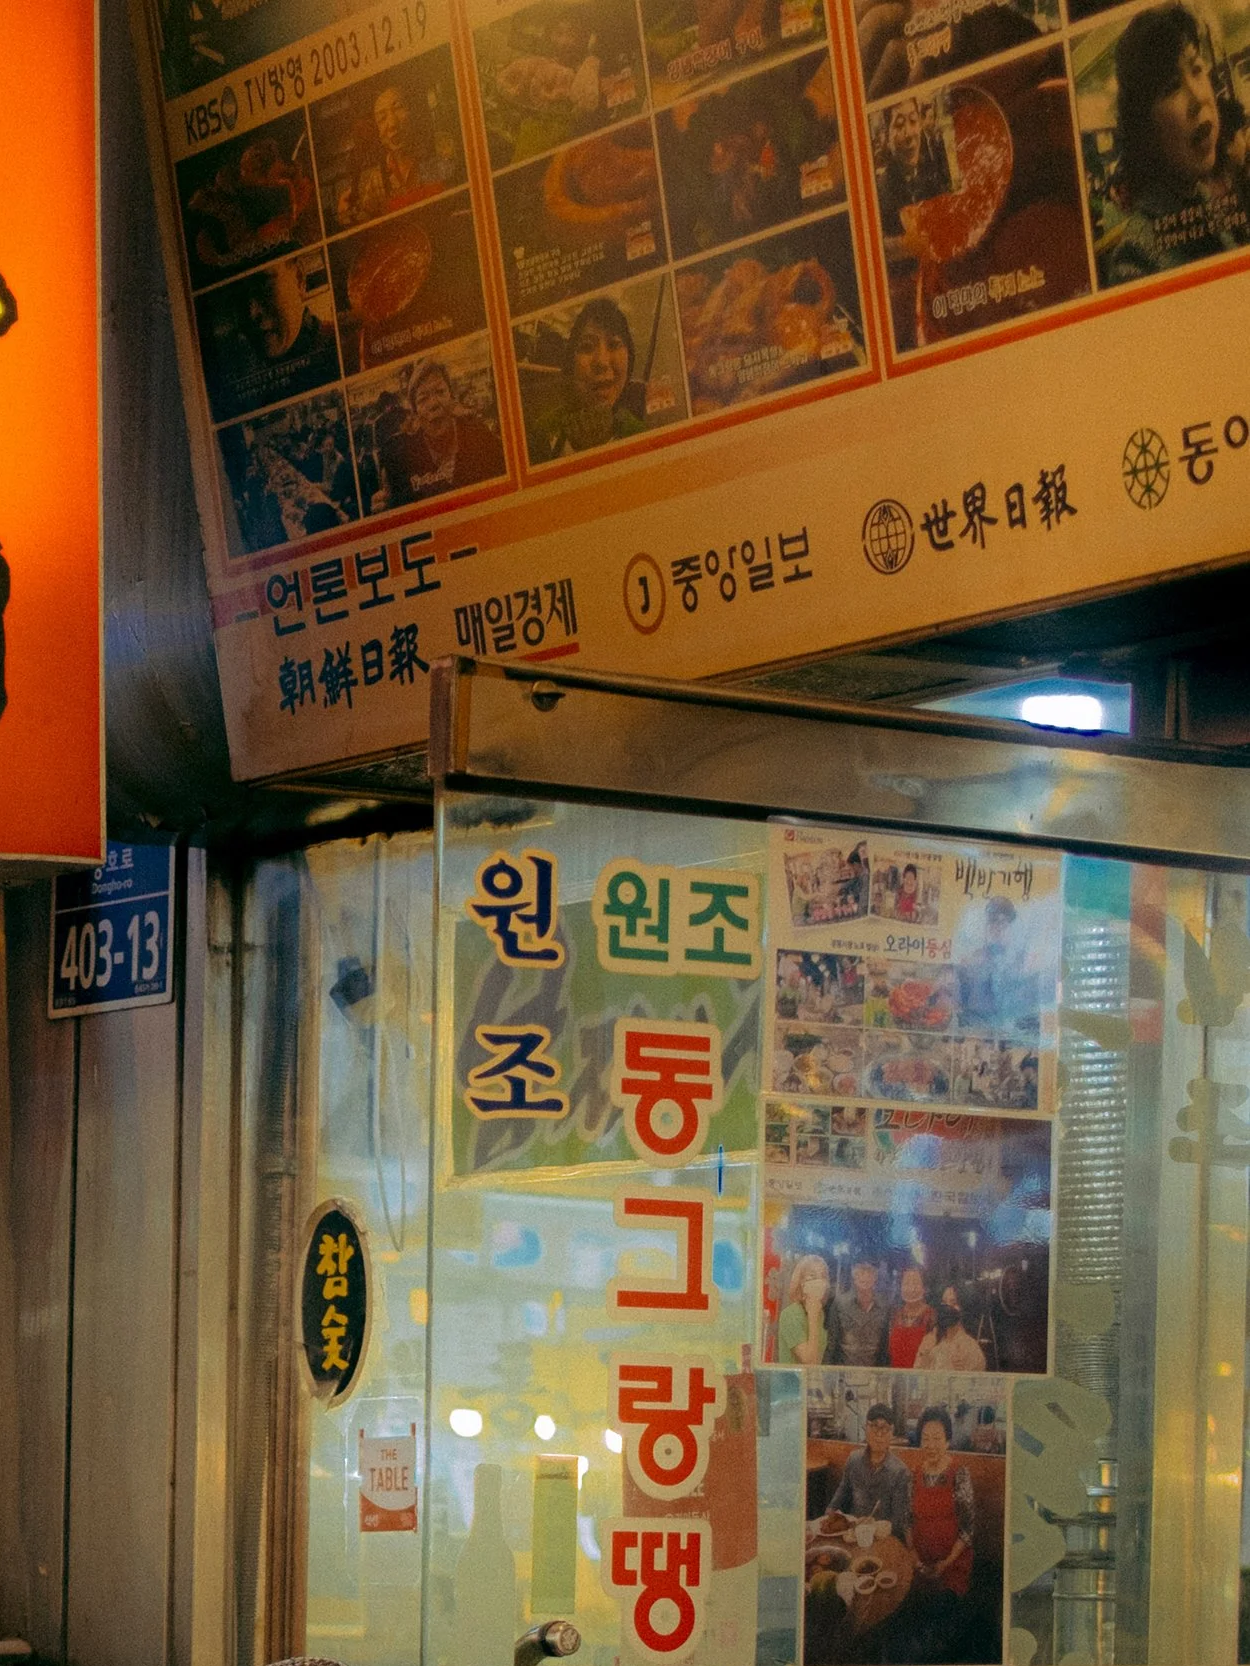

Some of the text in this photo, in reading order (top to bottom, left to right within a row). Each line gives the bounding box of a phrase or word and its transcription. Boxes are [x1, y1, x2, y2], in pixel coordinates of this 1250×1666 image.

[184, 97, 222, 146] KBS
[310, 1, 428, 87] 2003.12.19
[920, 463, 1078, 550] 世界日報
[265, 531, 442, 637] 언론보도
[671, 526, 813, 613] 중앙일보
[454, 578, 579, 655] 매일경제
[279, 623, 430, 716] 朝鮮日報
[60, 910, 160, 991] 403-13
[603, 870, 752, 967] 원조
[612, 1030, 717, 1653] 동그랑땡
[369, 1466, 410, 1493] TABLE
[380, 1448, 398, 1461] THE
